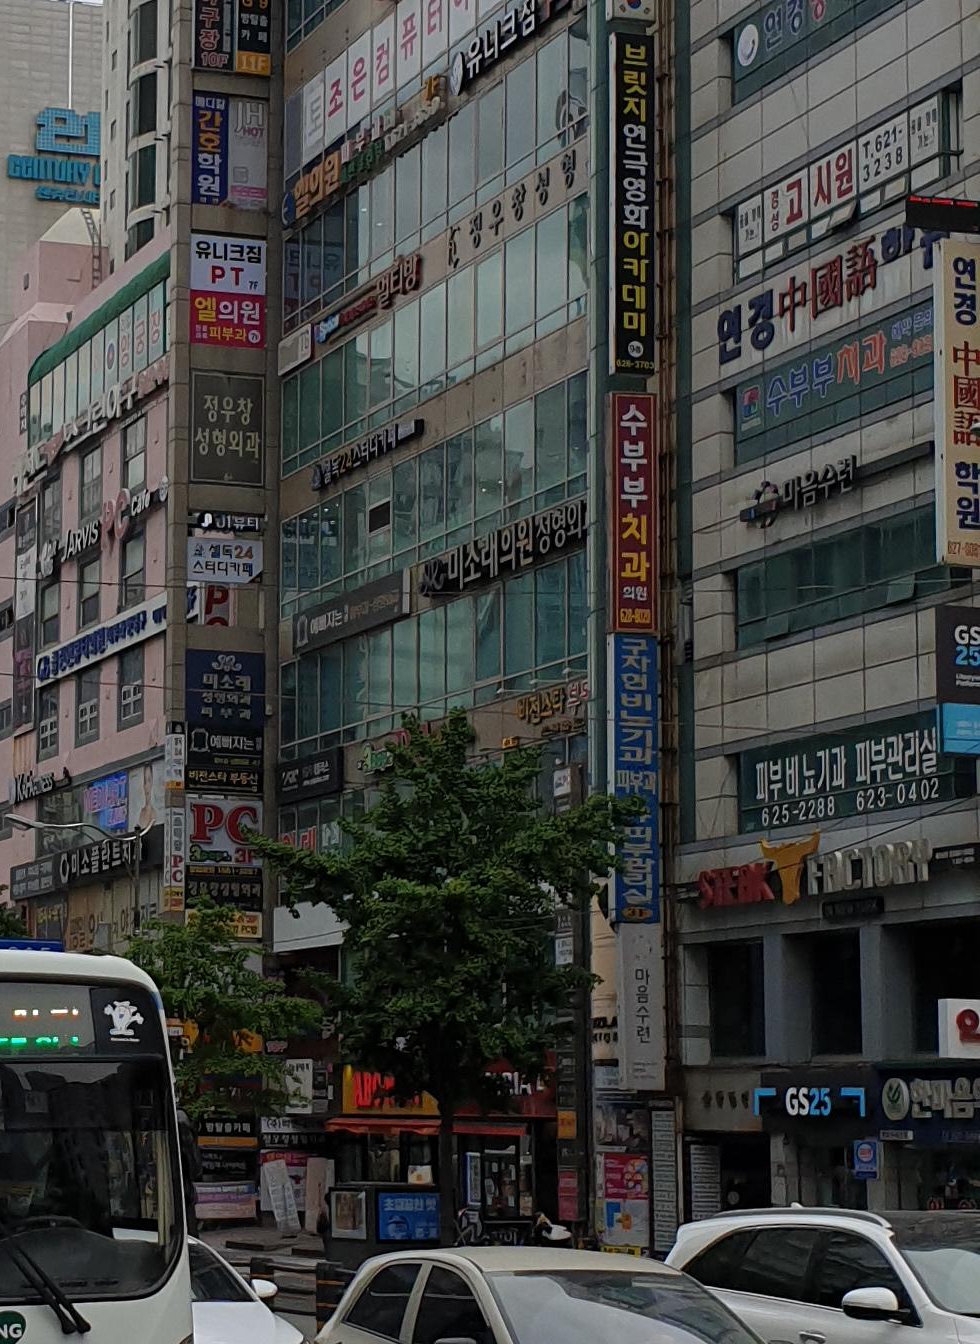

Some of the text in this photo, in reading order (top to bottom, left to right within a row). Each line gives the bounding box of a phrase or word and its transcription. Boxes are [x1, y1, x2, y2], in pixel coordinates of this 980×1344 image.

[784, 147, 854, 227] 고시원
[195, 240, 262, 264] 유니크짐
[194, 296, 261, 326] 엘의원
[952, 256, 978, 326] 연경
[209, 326, 247, 342] 피부과
[766, 329, 887, 418] 수부부치과
[203, 394, 254, 425] 정우창
[194, 427, 261, 458] 성형외과
[619, 403, 651, 601] 수부부치과 의원
[954, 461, 980, 530] 학원
[61, 520, 100, 564] JARVIS
[193, 561, 253, 577] 스터디카페
[955, 645, 980, 666] 25
[755, 727, 937, 803] 피부비뇨기과 피부관리실
[189, 802, 259, 845] PC
[761, 778, 939, 827] 625-2288 623-0402
[634, 967, 652, 1044] 마음수련
[785, 1086, 832, 1117] GS25
